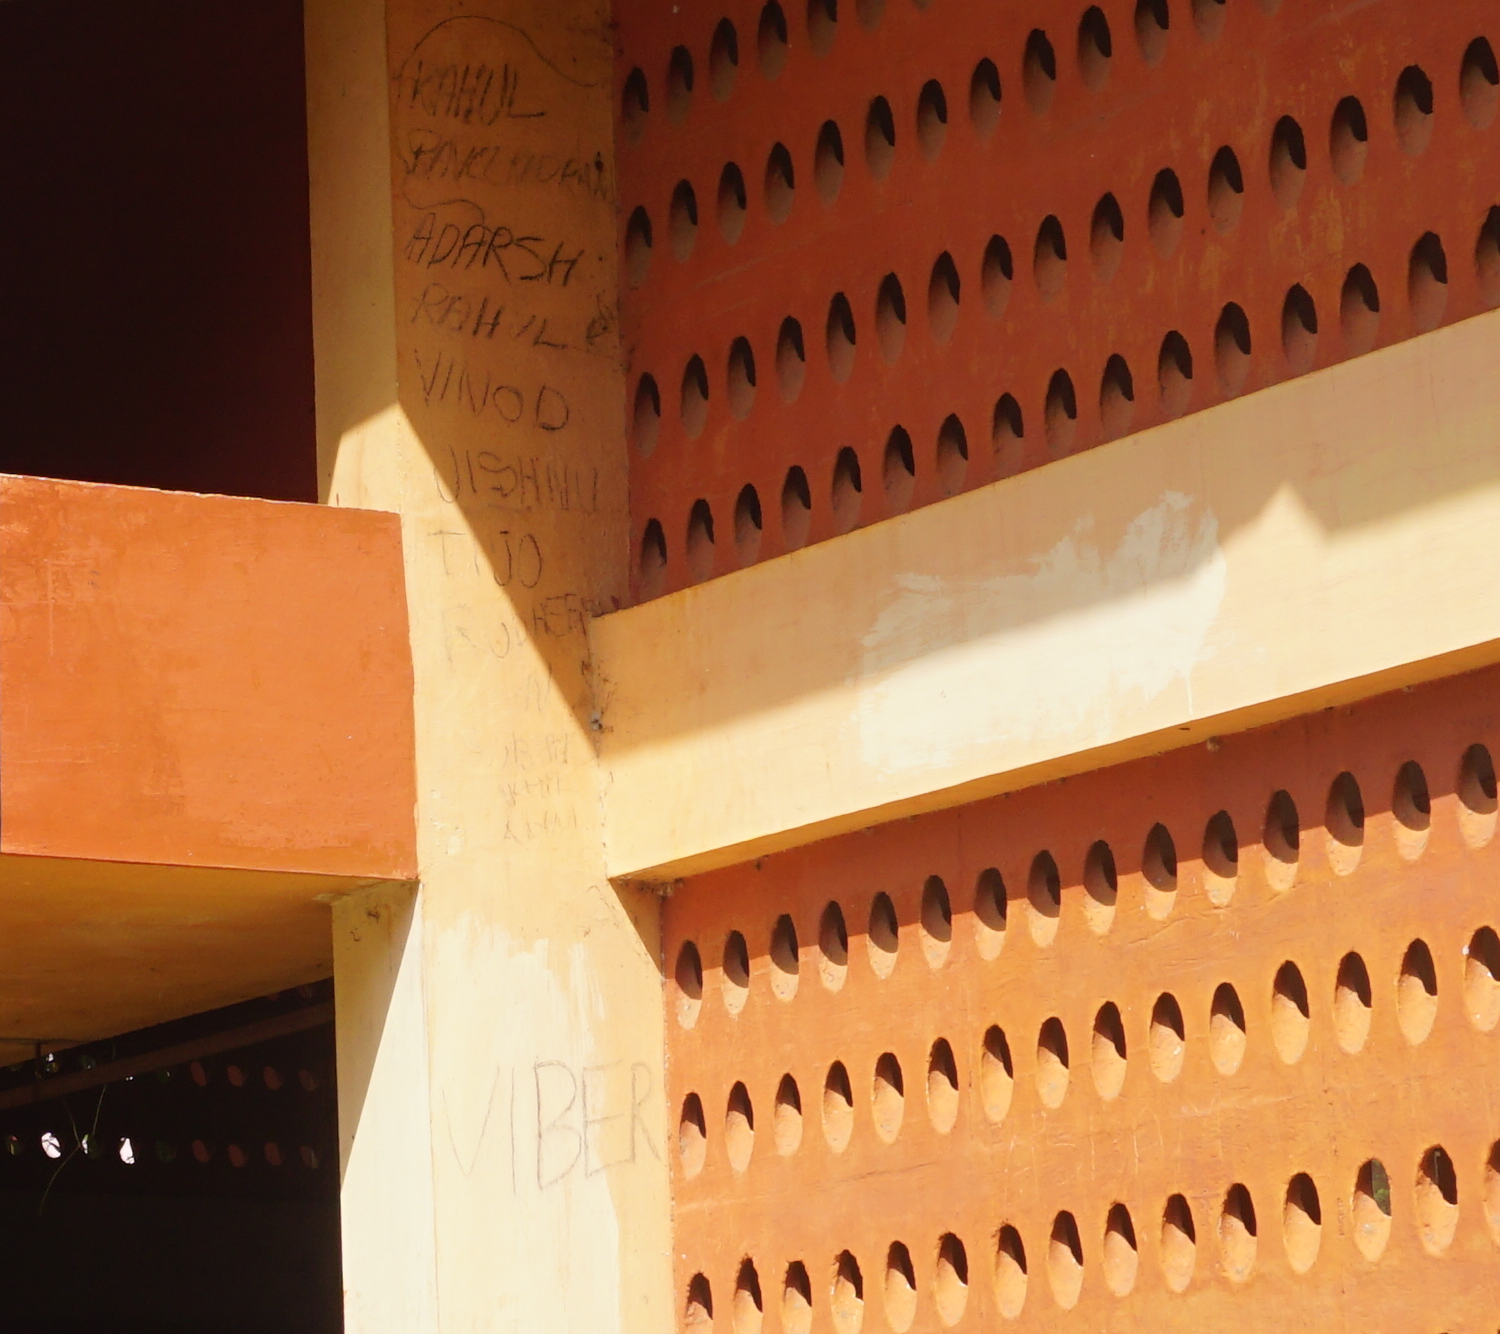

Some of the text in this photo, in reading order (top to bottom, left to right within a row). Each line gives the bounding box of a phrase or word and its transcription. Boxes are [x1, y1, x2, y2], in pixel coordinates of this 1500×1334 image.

[404, 212, 586, 289] ADARSH
[413, 348, 569, 431] VINOD
[441, 1058, 662, 1196] VIBER
